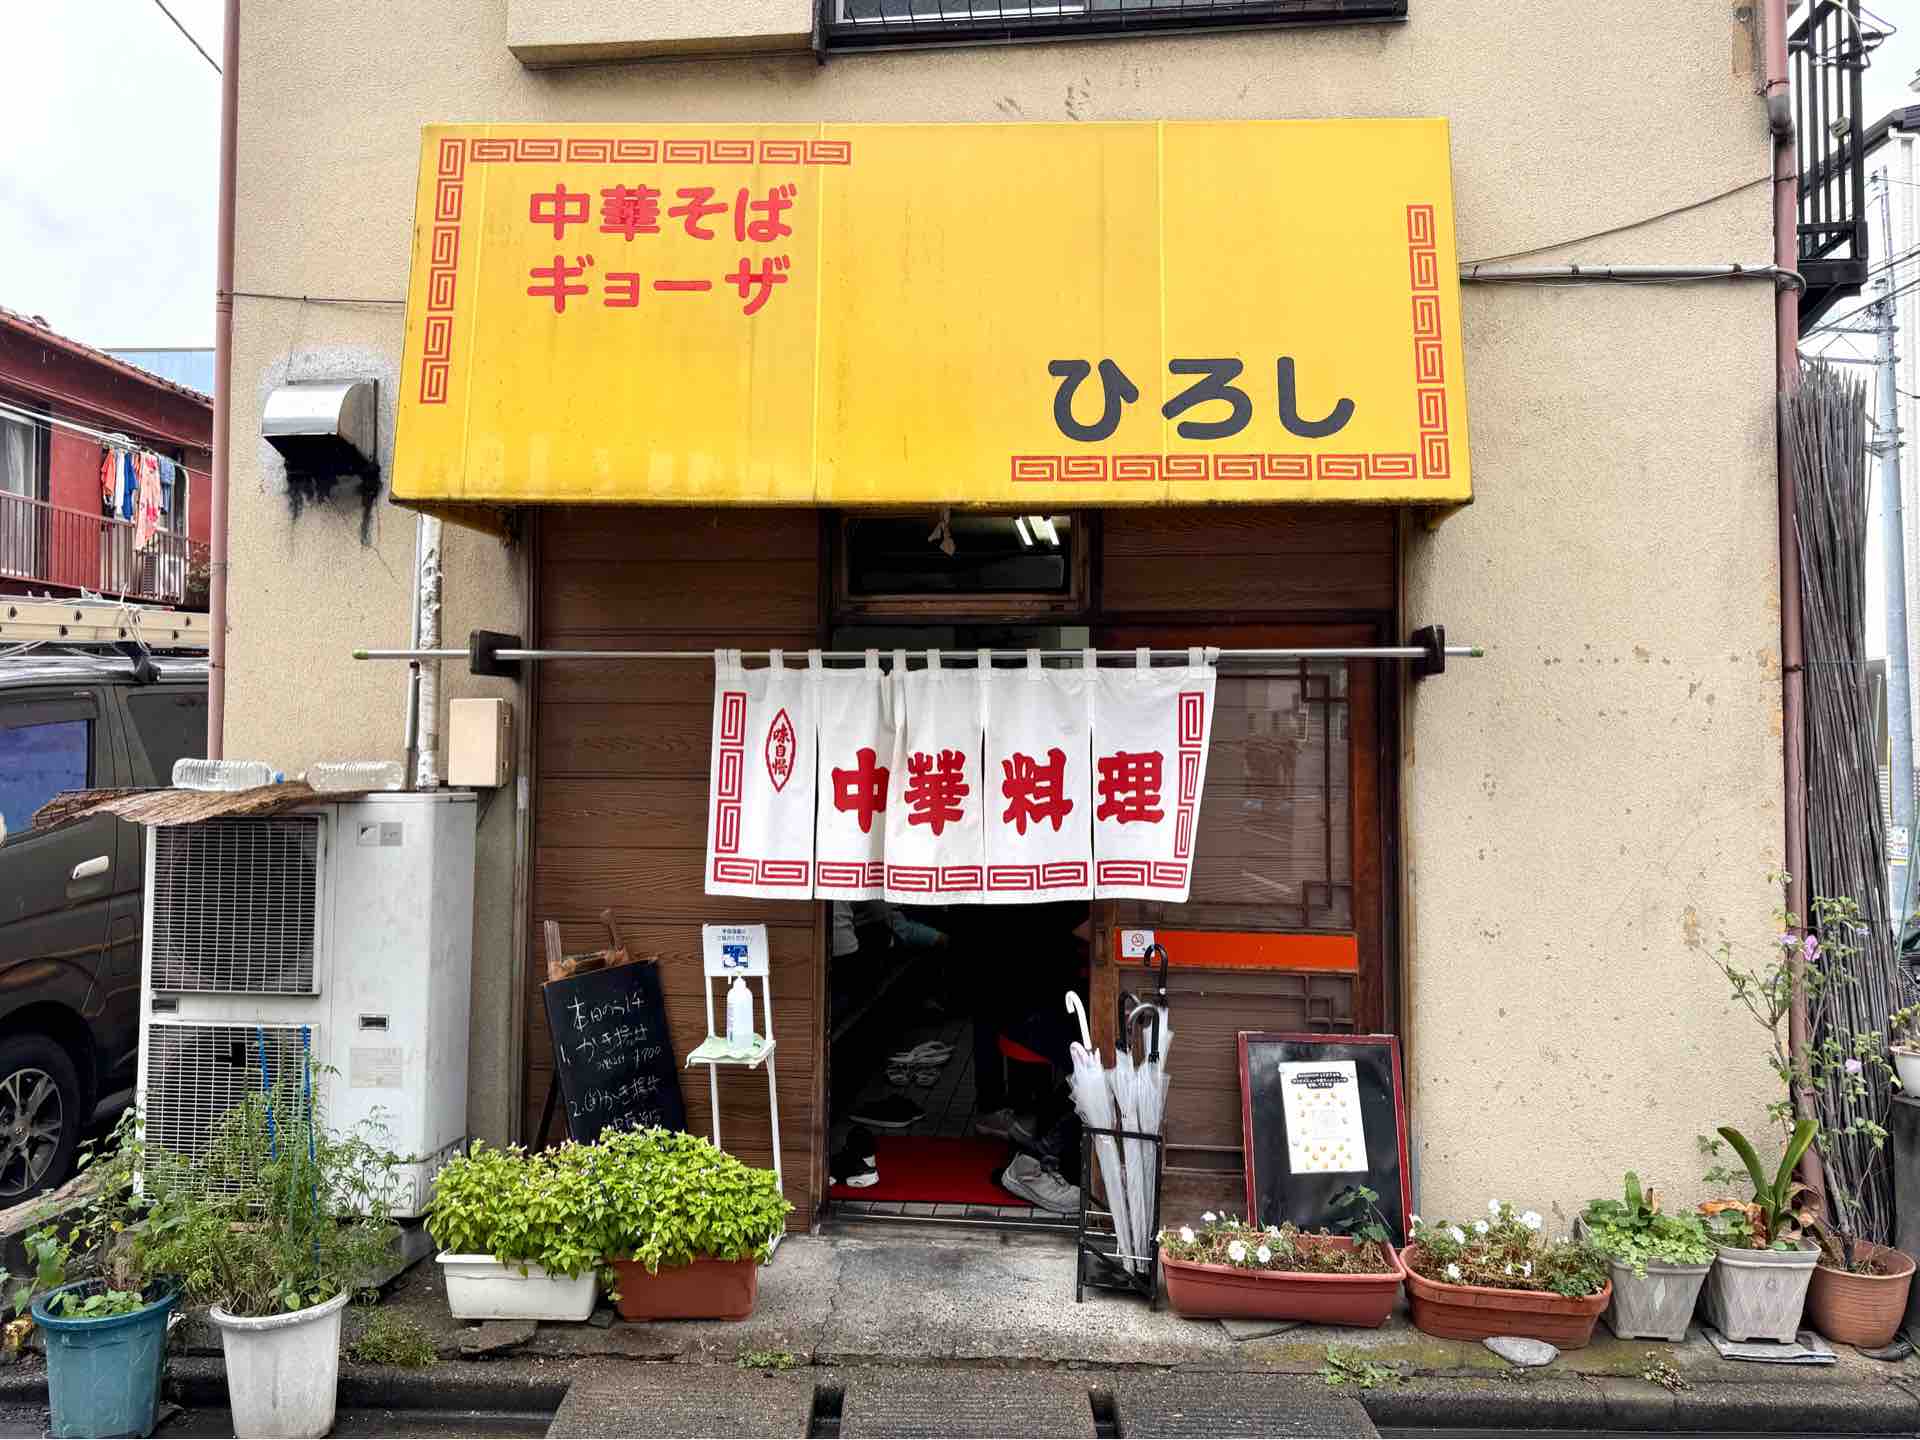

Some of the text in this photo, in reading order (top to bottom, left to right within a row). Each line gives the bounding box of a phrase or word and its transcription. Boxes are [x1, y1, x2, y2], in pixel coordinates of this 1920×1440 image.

[529, 183, 798, 242] 中華そば
[527, 254, 791, 315] ギョーザ
[1047, 356, 1356, 442] ひろし
[772, 723, 791, 777] 味自慢
[831, 746, 1168, 836] 中華料理
